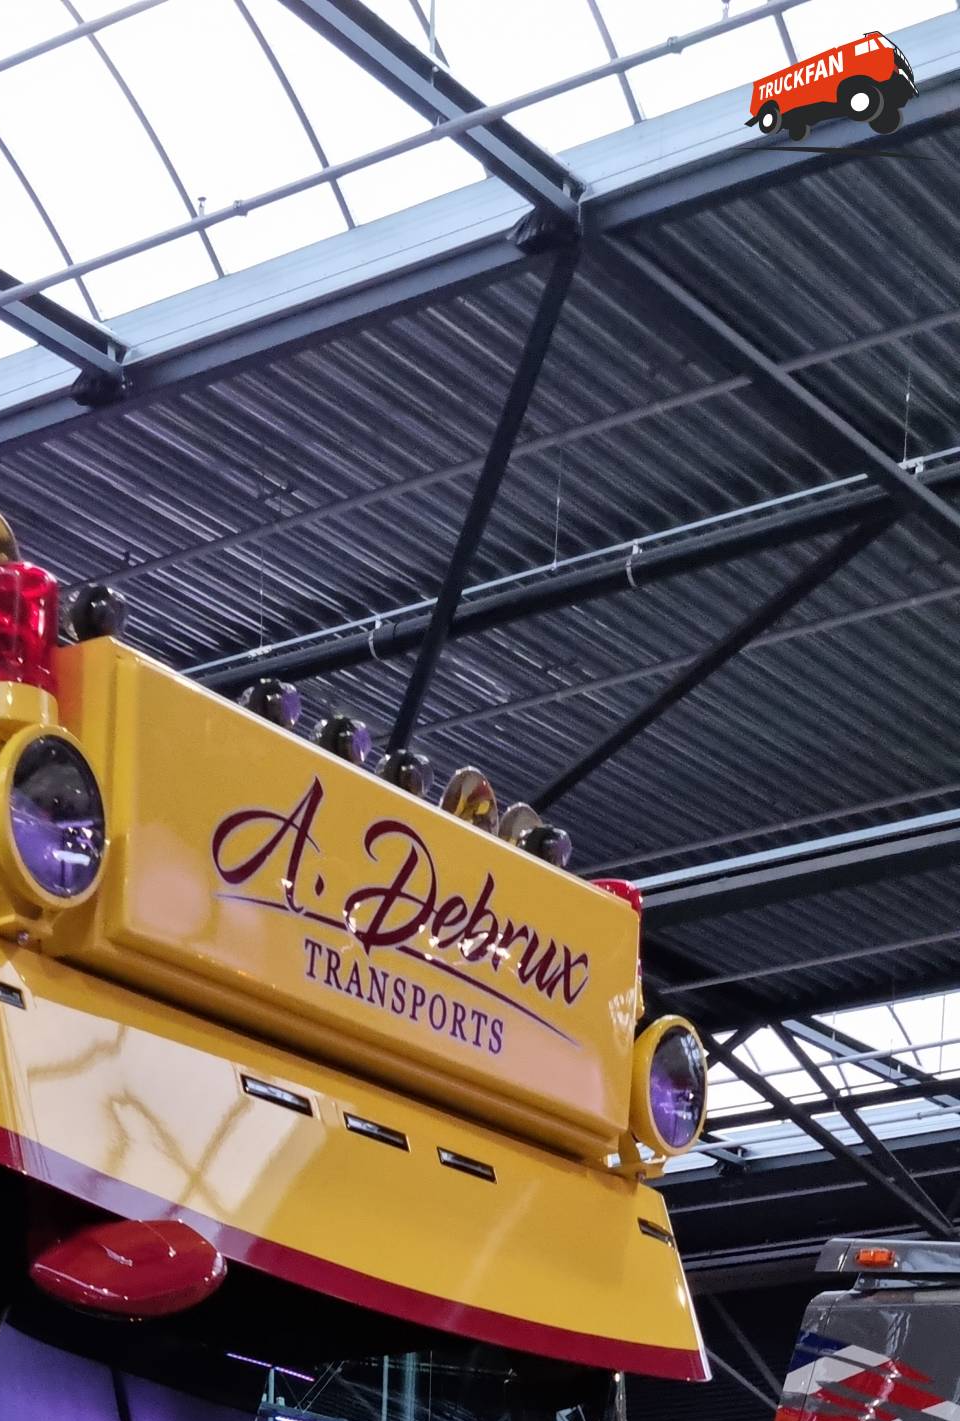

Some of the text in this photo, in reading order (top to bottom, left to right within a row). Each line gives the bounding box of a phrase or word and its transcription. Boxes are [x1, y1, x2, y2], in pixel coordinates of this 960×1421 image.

[211, 775, 589, 1005] A. Debrux
[304, 938, 505, 1055] TRANSPORTS
